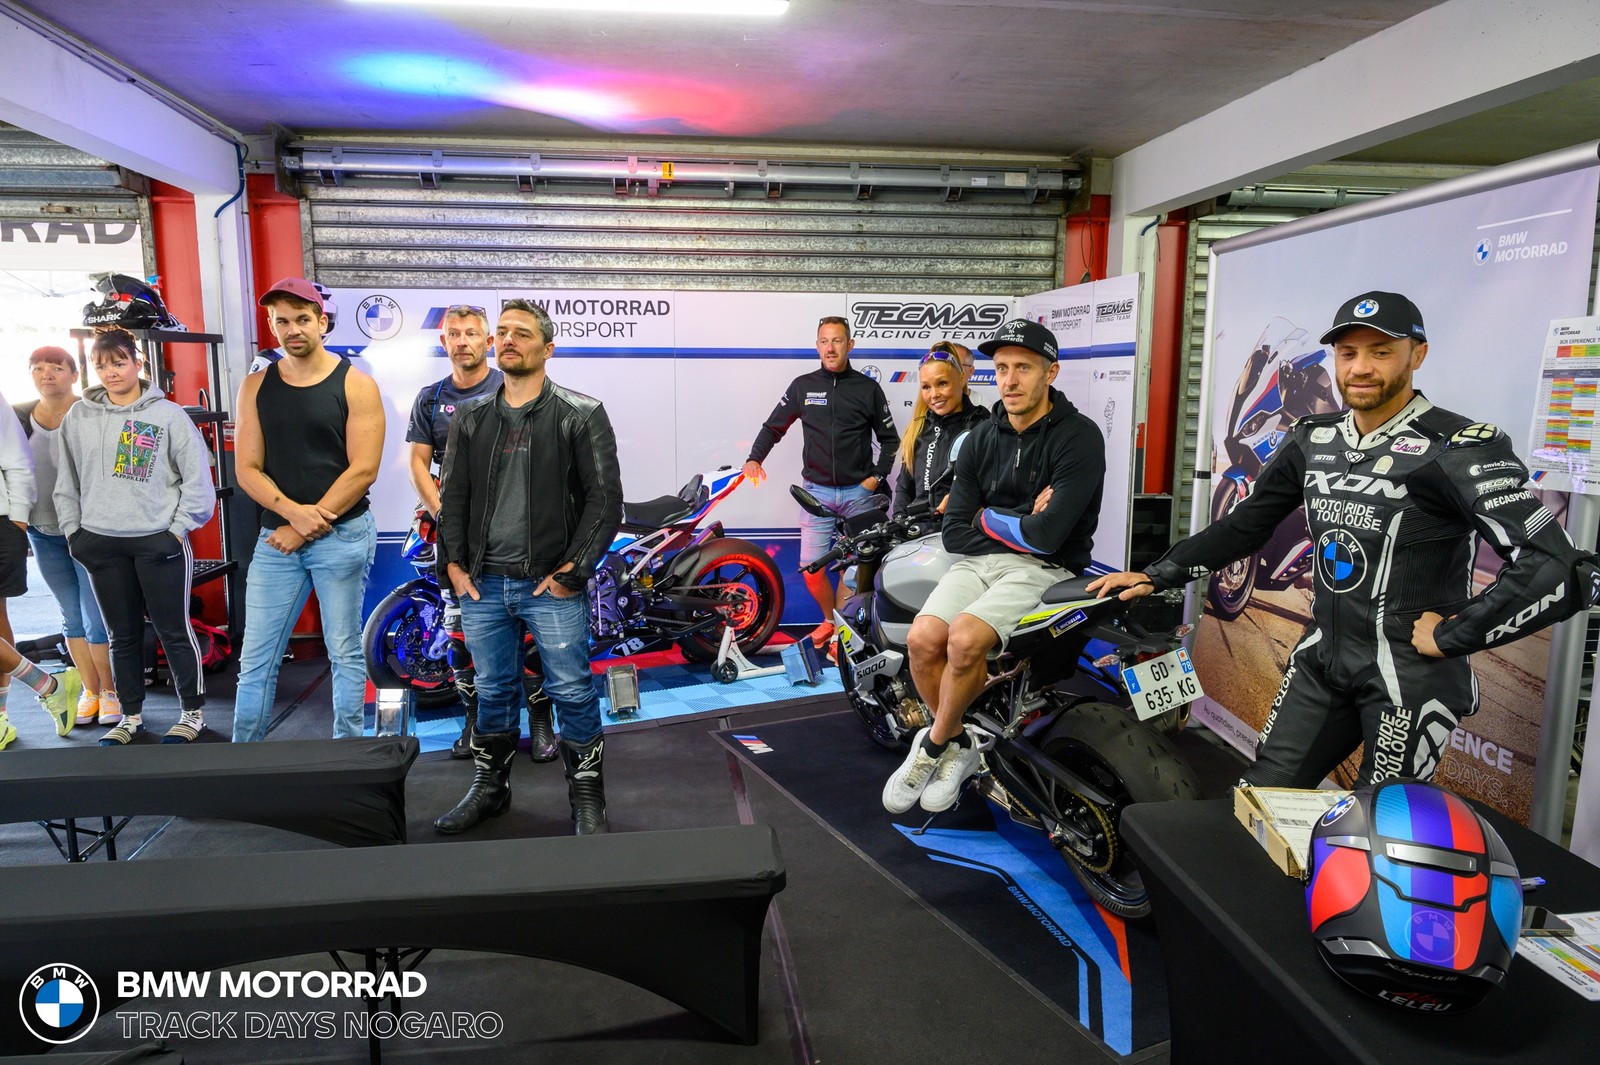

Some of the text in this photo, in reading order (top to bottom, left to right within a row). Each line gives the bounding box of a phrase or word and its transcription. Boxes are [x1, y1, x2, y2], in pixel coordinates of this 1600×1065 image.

[1498, 231, 1528, 247] BMW
[1495, 242, 1568, 263] MOTORRAD
[88, 312, 121, 324] SHARK
[555, 299, 671, 316] MOTORRAD
[852, 302, 1008, 330] TECMAS
[1052, 304, 1091, 319] BMW MOTORRAD
[1096, 299, 1133, 318] TECMAS
[853, 330, 931, 339] RACING
[941, 330, 995, 340] TEAM
[1051, 318, 1082, 331] MOTORSPORT
[1310, 498, 1375, 519] MOTO RIDE
[1321, 532, 1360, 554] BMW
[615, 637, 645, 657] 78
[856, 658, 887, 680] S1000
[1182, 661, 1192, 673] 78
[1176, 677, 1196, 698] KG
[1259, 666, 1298, 745] MOTO RIDE
[1377, 710, 1397, 752] RIDE
[1384, 706, 1413, 779] OULOUSE
[1448, 726, 1514, 775] ENCE
[1007, 885, 1073, 947] BMW MOTORRAD
[1412, 913, 1454, 931] BMW
[1378, 989, 1453, 1012] LELEU
